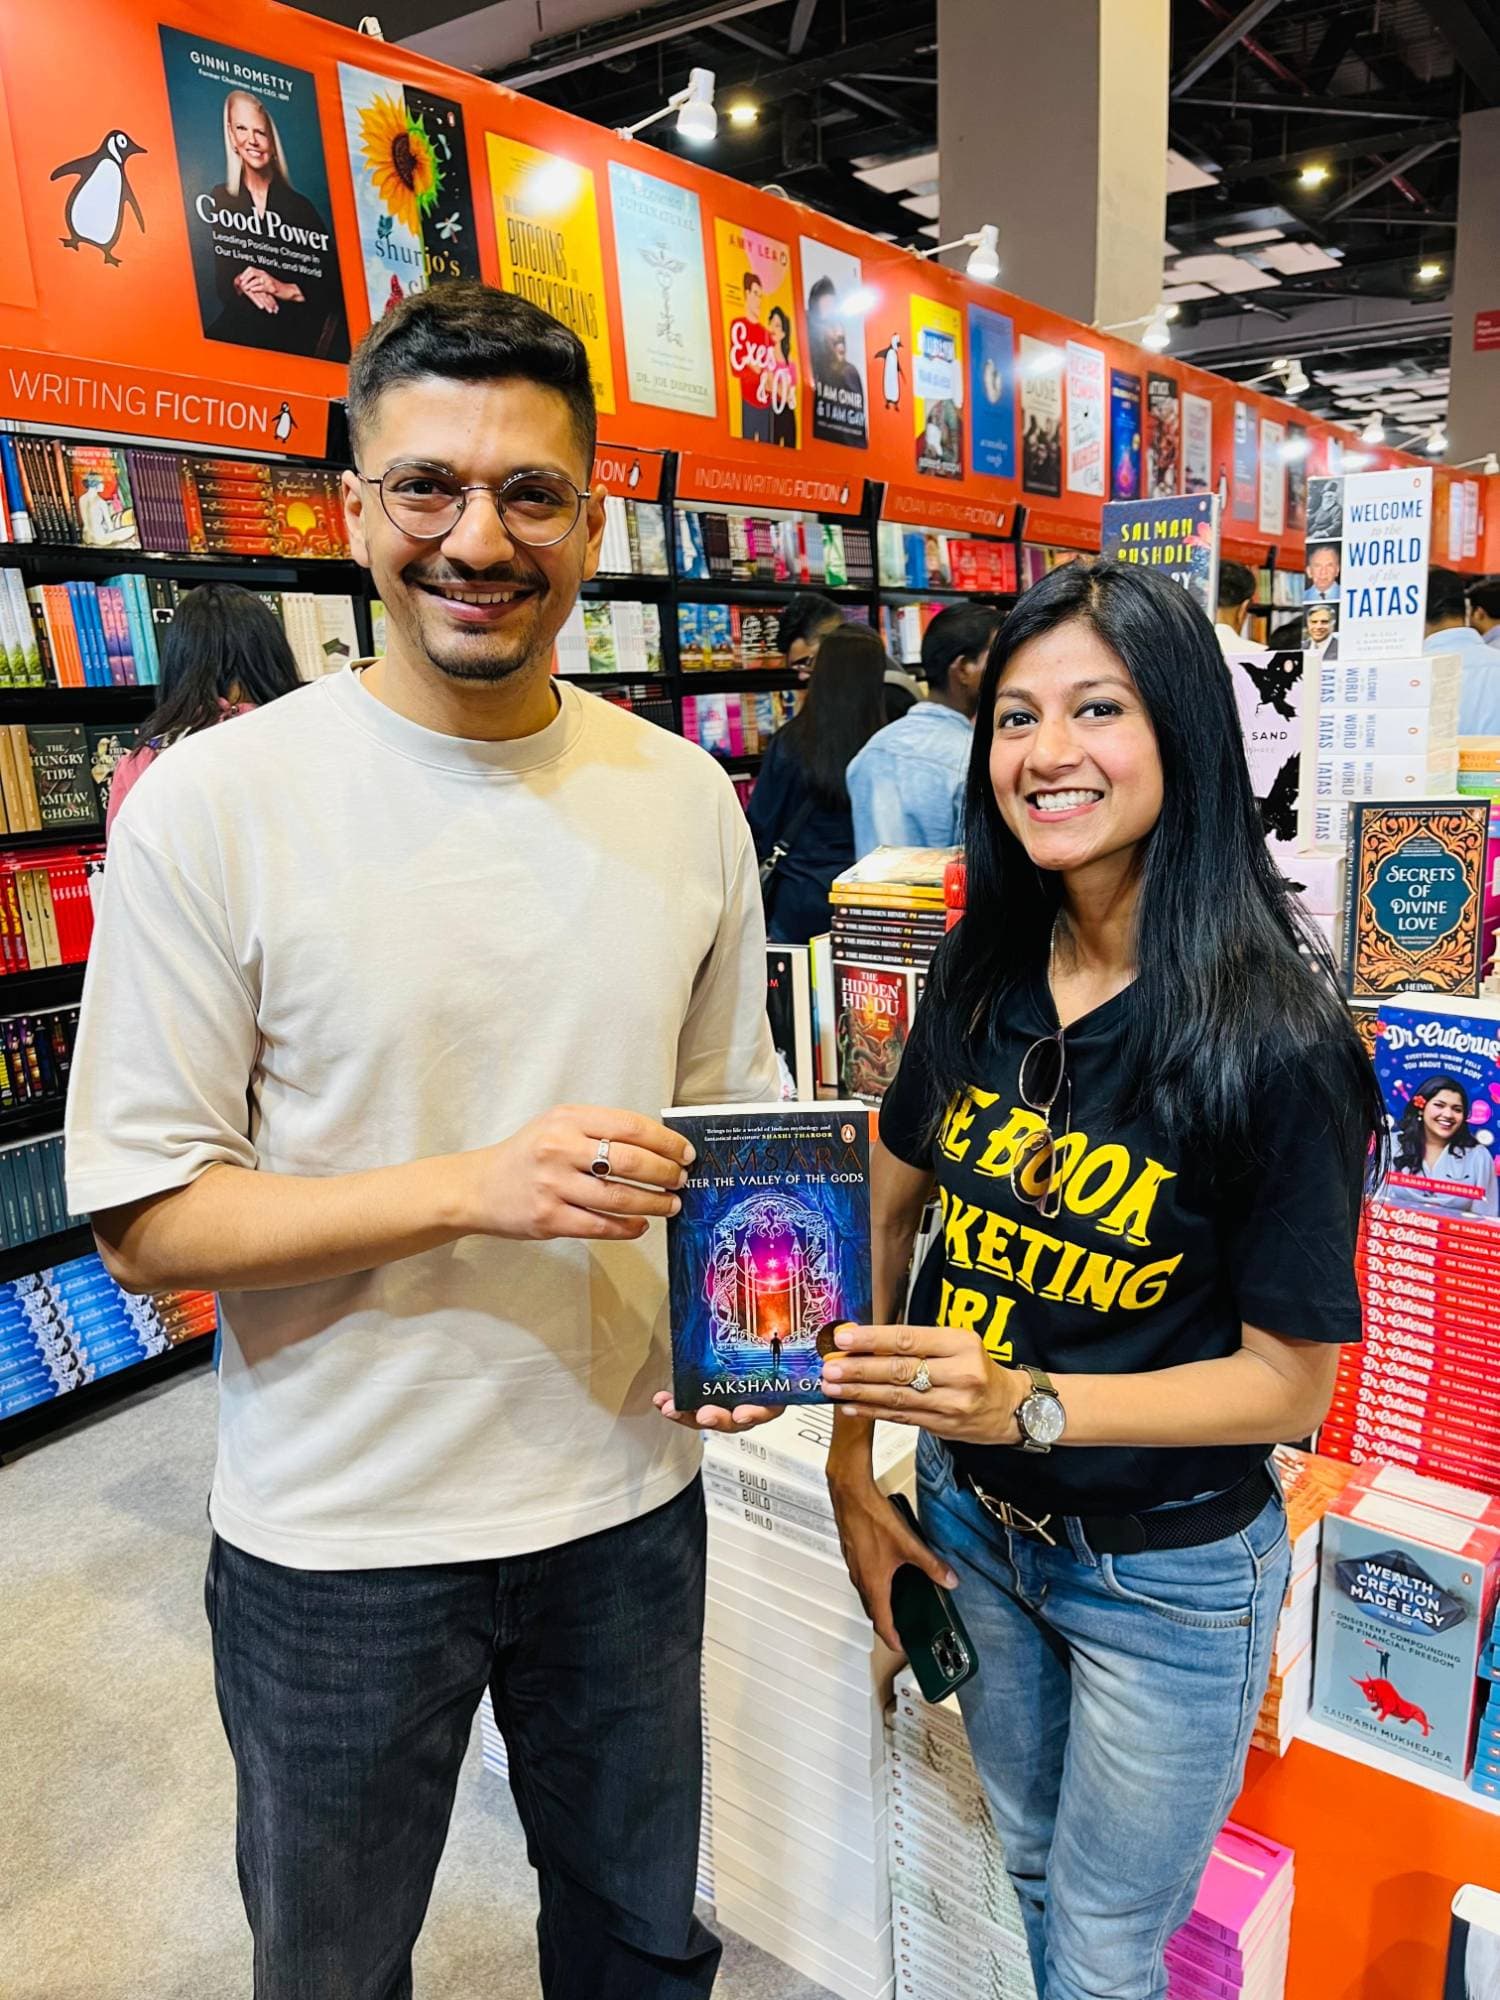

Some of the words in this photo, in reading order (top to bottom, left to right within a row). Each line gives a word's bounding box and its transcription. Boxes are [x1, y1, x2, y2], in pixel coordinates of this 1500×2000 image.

[190, 51, 230, 73] GINNI
[233, 64, 293, 92] ROMETTY
[195, 194, 261, 236] Good
[264, 210, 329, 251] Power
[212, 231, 247, 248] Leading
[248, 238, 279, 254] Positive
[280, 246, 311, 263] Change
[312, 254, 320, 263] in
[215, 246, 231, 256] Our
[233, 249, 256, 263] Lives,
[257, 254, 280, 268] Work,
[281, 260, 298, 272] and
[299, 263, 322, 278] World
[375, 233, 461, 277] shurjo's
[507, 217, 567, 281] BITCOINS
[729, 233, 753, 252] AMY
[758, 243, 778, 262] LEA
[730, 321, 777, 371] Exes
[8, 368, 146, 417] WRITING
[155, 389, 268, 433] FICTION
[756, 371, 770, 404] &
[823, 384, 838, 400] AM
[838, 388, 863, 408] ONIR
[816, 403, 825, 416] &
[831, 407, 846, 420] AM
[847, 409, 866, 427] GAY
[695, 467, 743, 491] INDIAN
[743, 473, 793, 497] WRITING
[794, 480, 840, 501] FICTION
[1350, 499, 1423, 522] WELCOME
[1121, 518, 1193, 542] SALMAN
[1349, 537, 1421, 567] WORLD
[1346, 584, 1420, 618] TATAS
[1320, 668, 1336, 703] TATAS
[1344, 667, 1359, 703] WORLD
[1368, 667, 1377, 702] WELCOME
[1252, 731, 1288, 740] SAND
[1318, 714, 1335, 749] TATAS
[1344, 714, 1358, 749] WORLD
[1366, 714, 1376, 749] WELCOME
[30, 753, 85, 767] HUNGRY
[46, 744, 66, 752] THE
[45, 768, 76, 781] TIDE
[1317, 761, 1333, 796] TATAS
[1342, 761, 1356, 796] WORLD
[1364, 761, 1373, 795] WELCOME
[39, 792, 89, 806] AMITAV
[42, 807, 90, 820] GHOSH
[1315, 807, 1331, 841] TATAS
[1385, 865, 1456, 884] SECRETS
[1390, 898, 1447, 914] DIVINE
[1408, 884, 1431, 898] OF
[1398, 916, 1438, 931] LOVE
[841, 977, 899, 999] HIDDEN
[860, 972, 878, 982] THE
[841, 991, 900, 1016] HINDU
[1383, 1025, 1419, 1050] Dr
[1415, 1021, 1500, 1062] Cuterus
[699, 1146, 863, 1173] AMSARA
[682, 1178, 710, 1190] NTER
[714, 1176, 735, 1188] THE
[739, 1174, 781, 1186] VALLEY
[785, 1174, 801, 1184] OF
[806, 1173, 827, 1184] THE
[831, 1172, 864, 1183] GODS
[1370, 1204, 1390, 1221] Dr
[1369, 1221, 1389, 1239] Dr
[702, 1379, 792, 1396] SAKSHAM
[799, 1378, 823, 1392] GA
[740, 1438, 767, 1461] BUILD
[739, 1469, 768, 1492] BUILD
[742, 1489, 771, 1511] BUILD
[744, 1509, 773, 1531] BUILD
[1357, 1574, 1440, 1612] CREATION
[1365, 1561, 1434, 1595] WEALTH
[1351, 1585, 1398, 1611] MADE
[1401, 1603, 1444, 1627] EASY
[1331, 1611, 1387, 1635] CONSISTENT
[1389, 1632, 1461, 1663] COMPOUNDING
[1336, 1620, 1354, 1631] FOR
[1357, 1628, 1405, 1652] FINANCIAL
[1409, 1647, 1455, 1669] FREEDOM
[1323, 1705, 1377, 1733] SAURABH
[1381, 1729, 1453, 1763] MUKHERJEA
